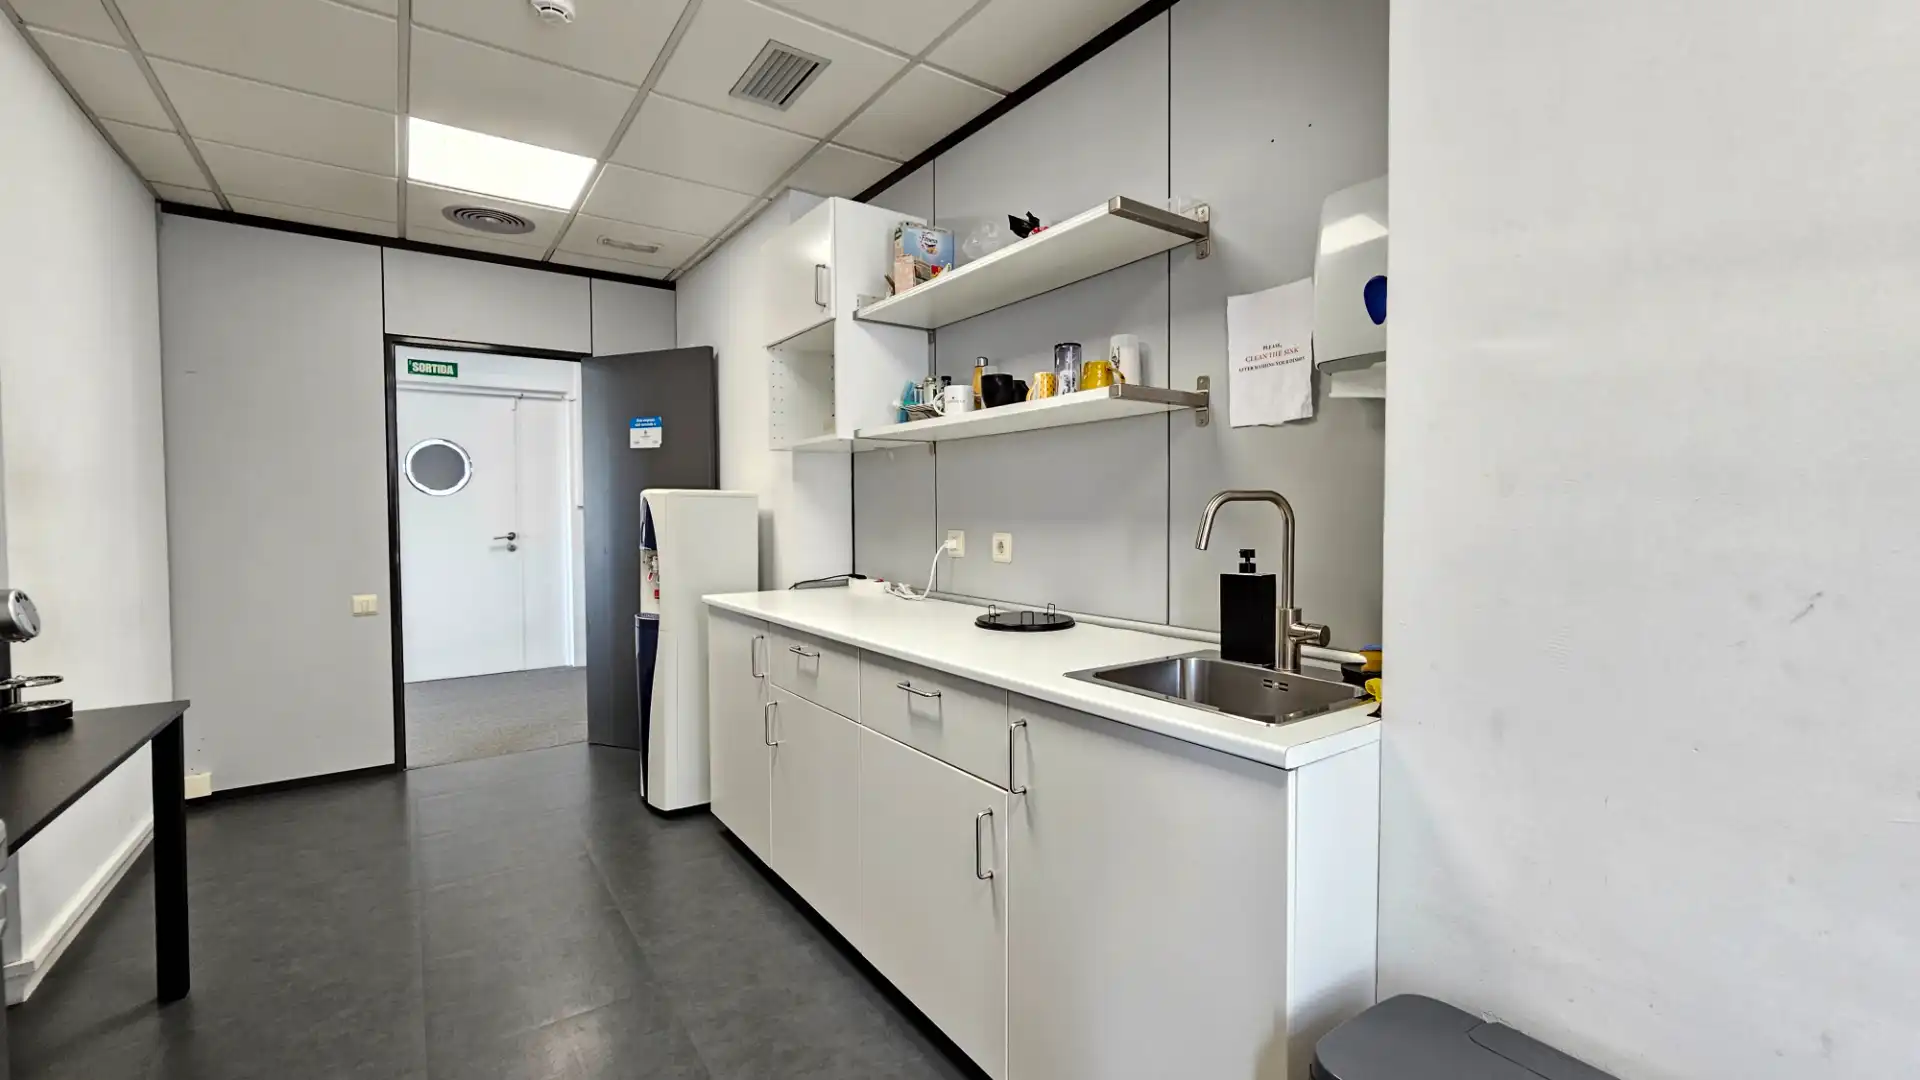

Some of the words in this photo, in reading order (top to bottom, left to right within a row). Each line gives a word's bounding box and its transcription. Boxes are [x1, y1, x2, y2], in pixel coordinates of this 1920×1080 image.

[1245, 353, 1267, 362] CLEAN
[1269, 350, 1282, 358] THE
[1284, 347, 1299, 356] SINK
[412, 362, 454, 375] SORTIDA
